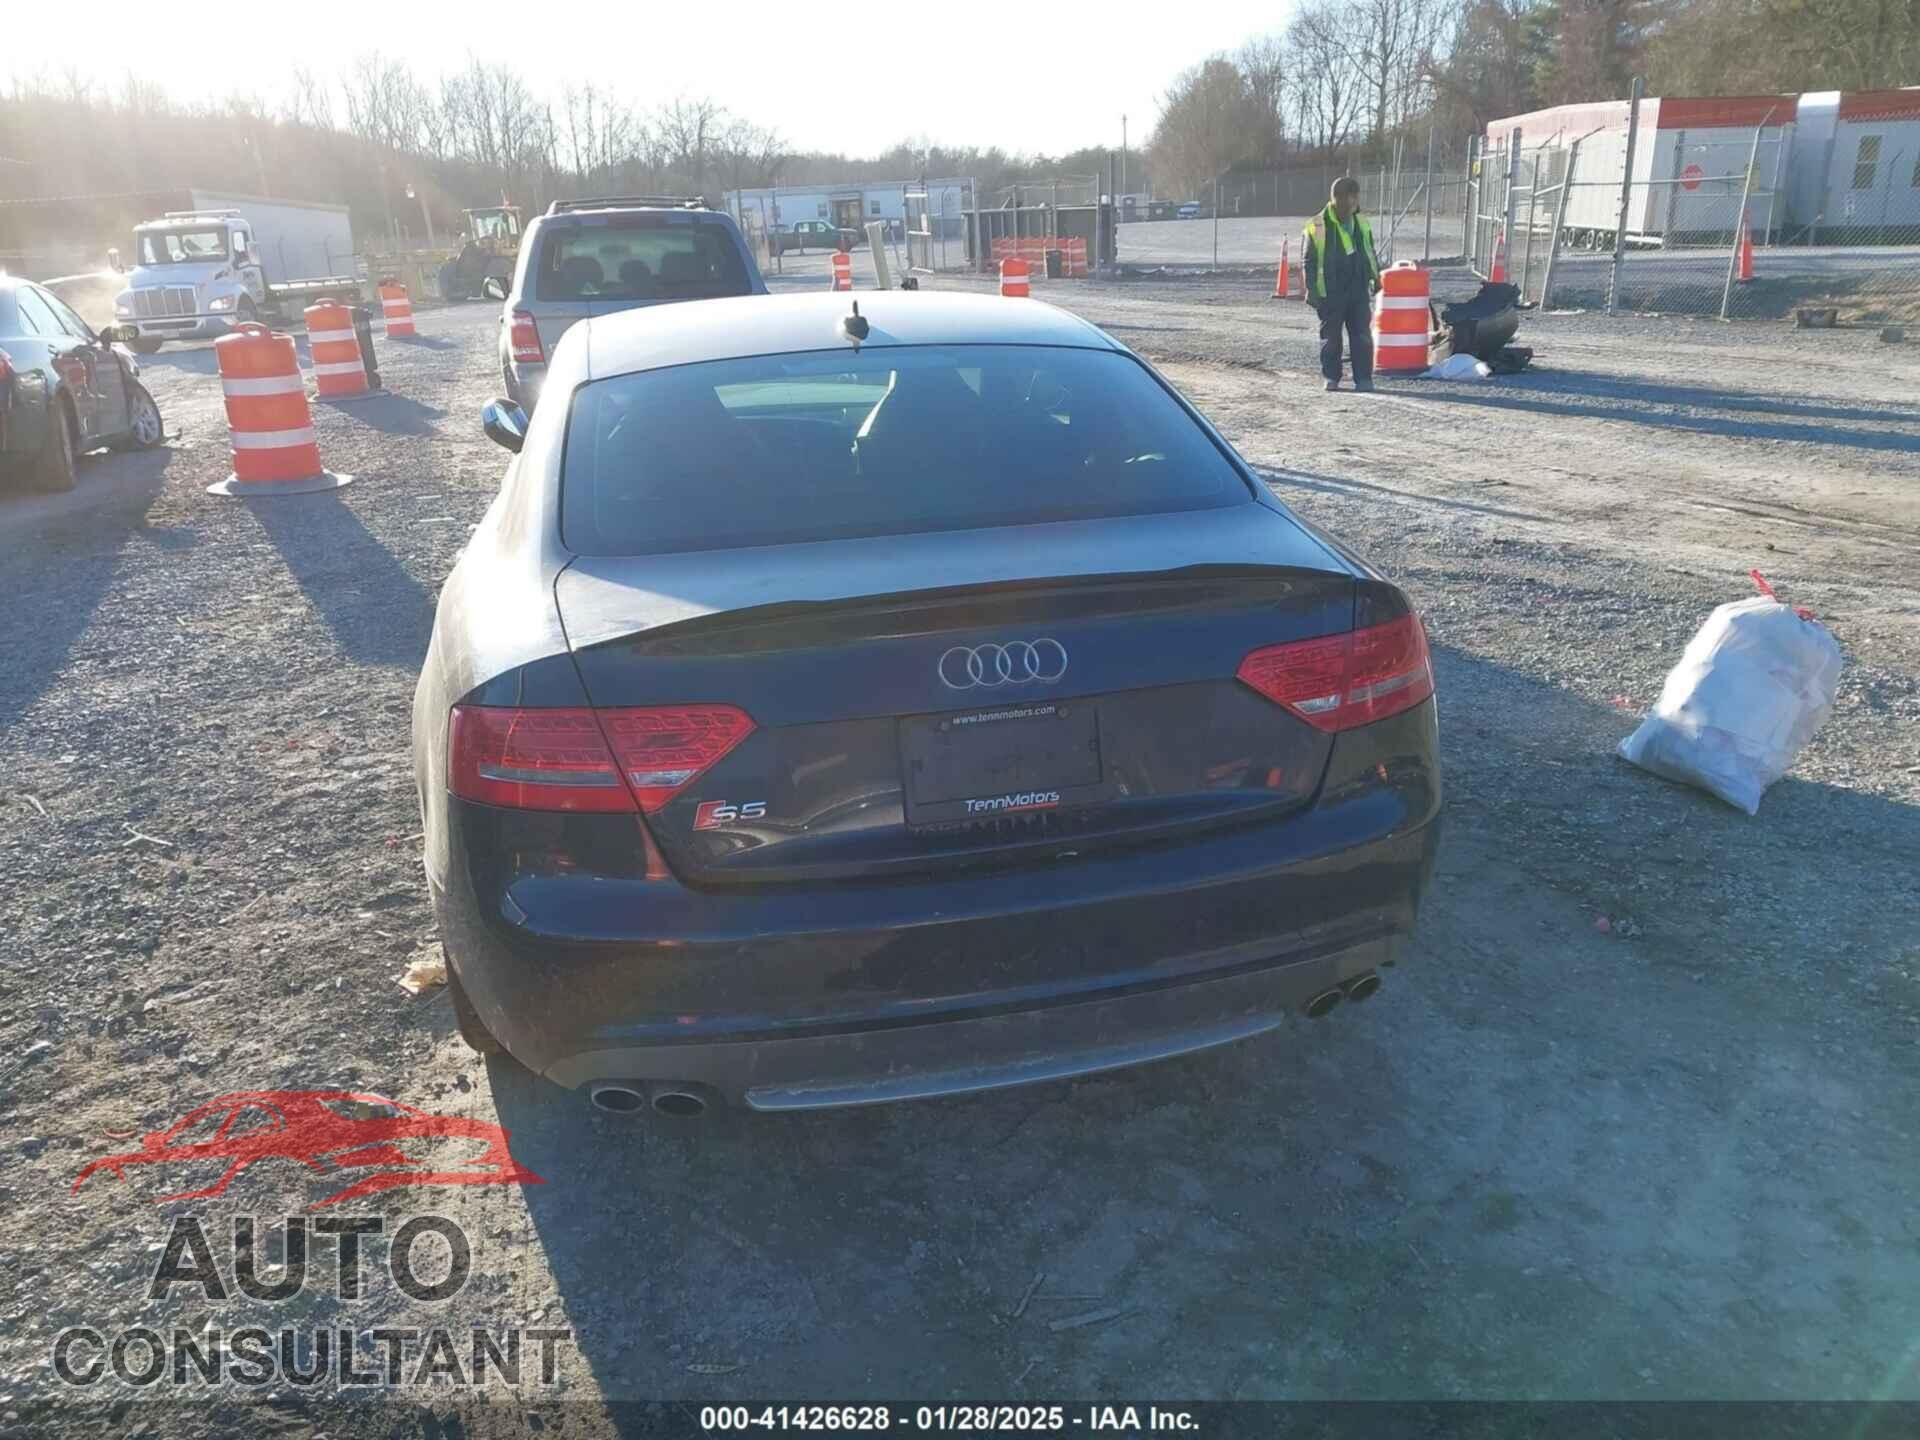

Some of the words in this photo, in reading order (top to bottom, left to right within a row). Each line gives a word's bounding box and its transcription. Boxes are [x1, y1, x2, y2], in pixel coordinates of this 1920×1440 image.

[952, 705, 1056, 725] www.tennmotors.com
[708, 801, 768, 823] S5
[965, 791, 1060, 813] TennMotors
